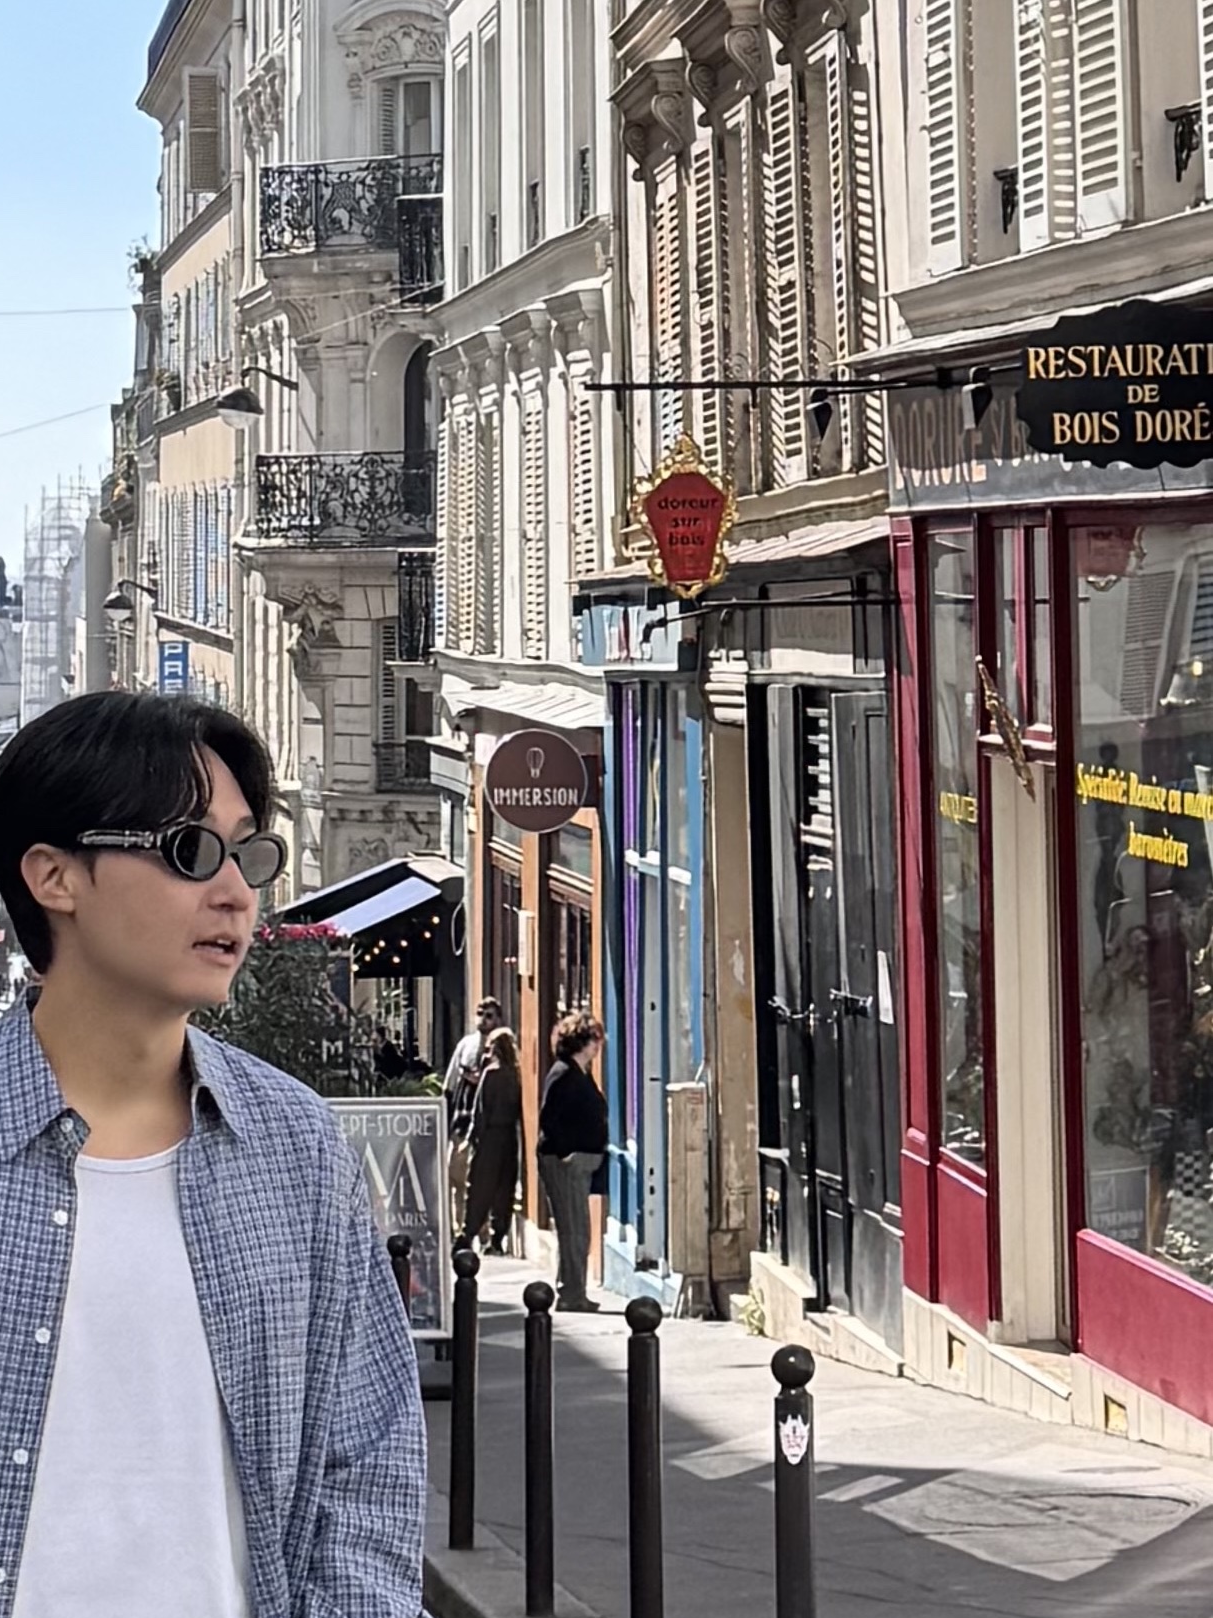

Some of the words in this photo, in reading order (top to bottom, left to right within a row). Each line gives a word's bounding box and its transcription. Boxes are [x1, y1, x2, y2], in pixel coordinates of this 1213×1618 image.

[1127, 384, 1160, 403] DE
[1053, 411, 1120, 445] BOIS
[657, 497, 718, 509] doreur
[671, 517, 700, 528] sur
[668, 532, 705, 546] bois
[493, 787, 579, 806] IMMERSION
[384, 1213, 428, 1228] PARIS
